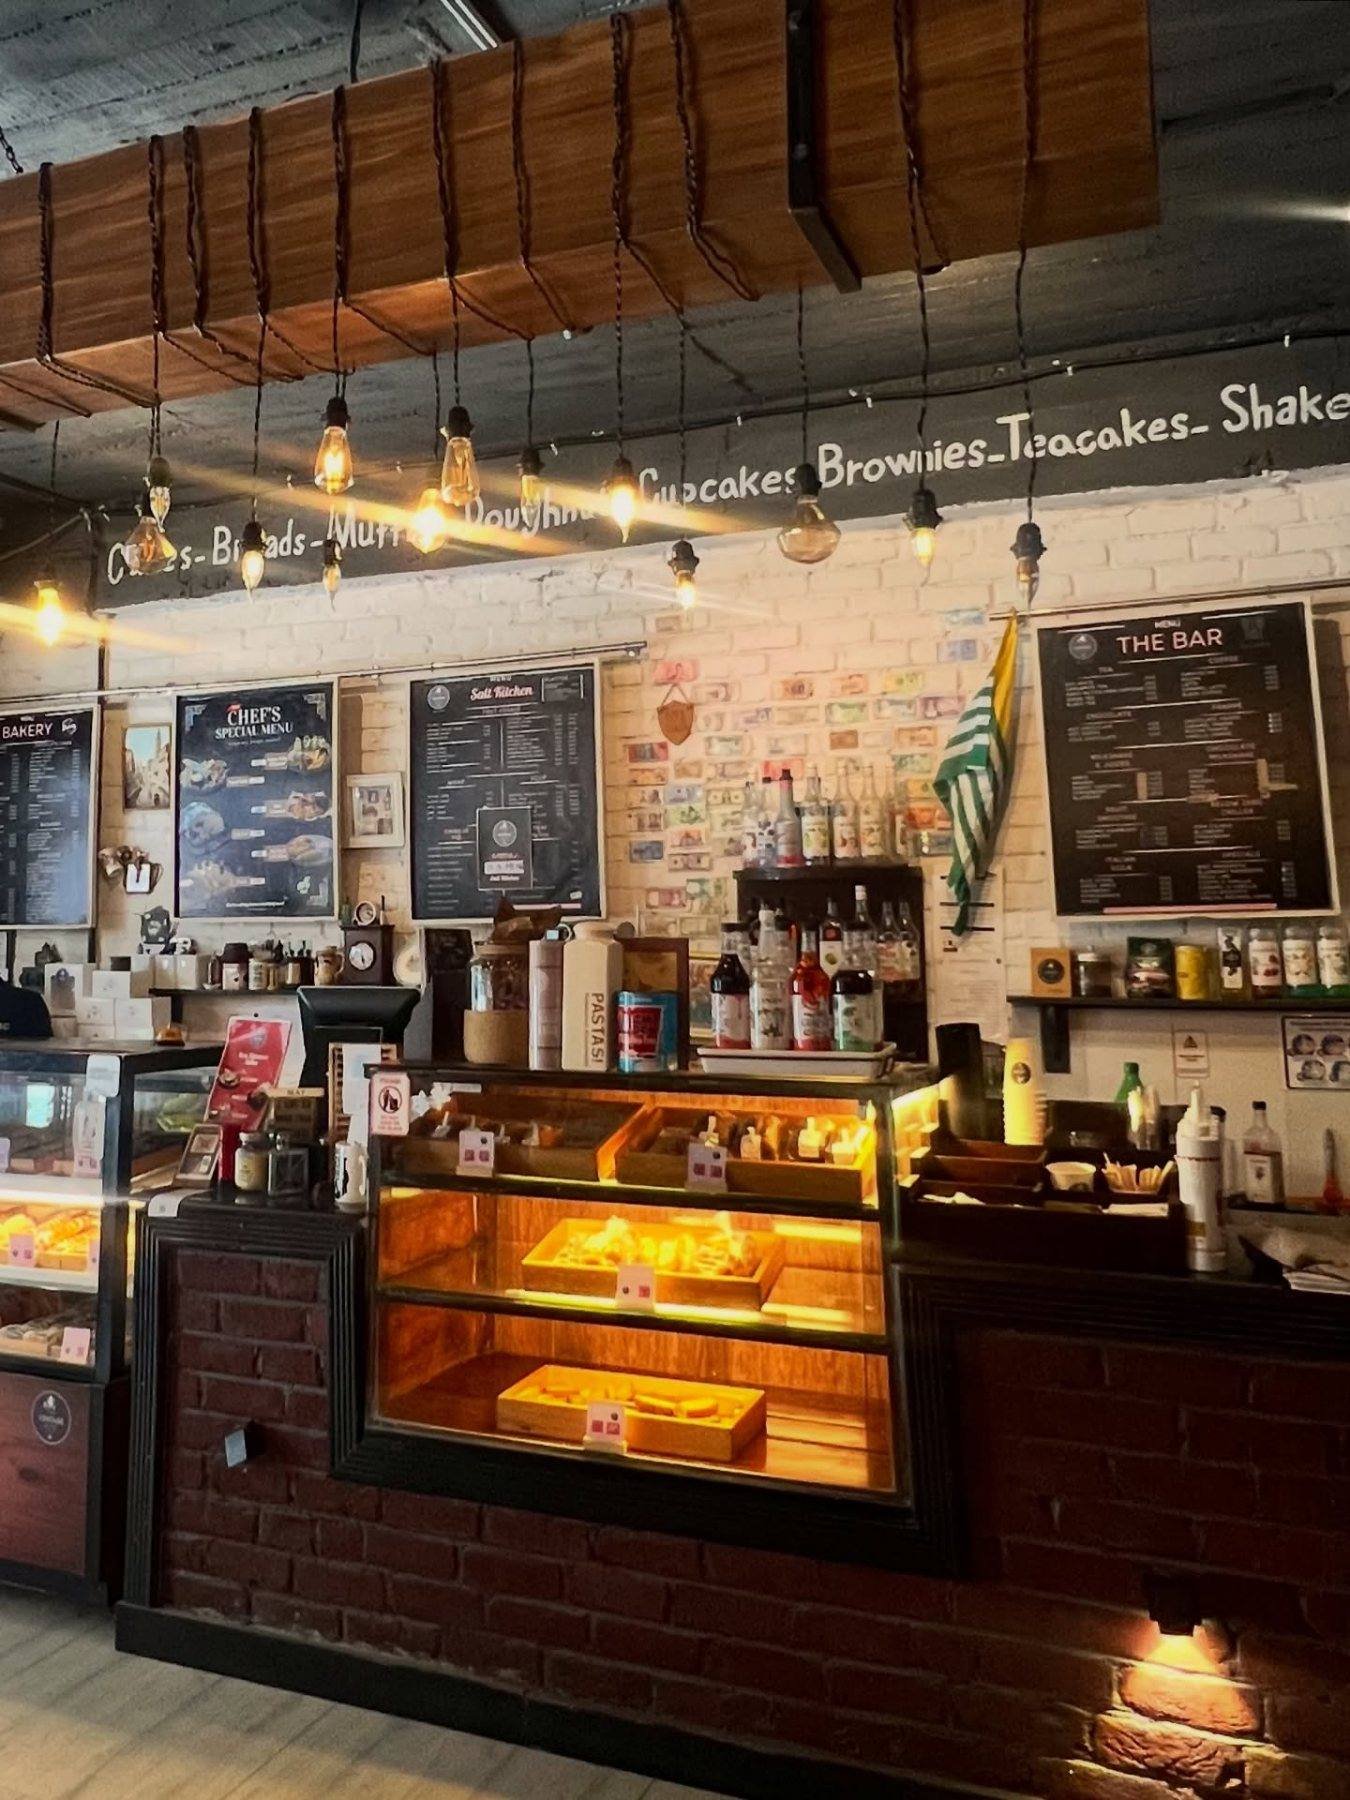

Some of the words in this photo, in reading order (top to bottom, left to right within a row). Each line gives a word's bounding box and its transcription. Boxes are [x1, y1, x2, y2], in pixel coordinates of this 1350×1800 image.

[1116, 633, 1164, 654] THE
[1172, 628, 1223, 650] BAR
[493, 685, 534, 699] Kitchen
[227, 706, 281, 726] CHEF'S
[2, 722, 53, 739] BAKERY
[214, 726, 257, 740] SPECIAL
[259, 722, 293, 735] MENU
